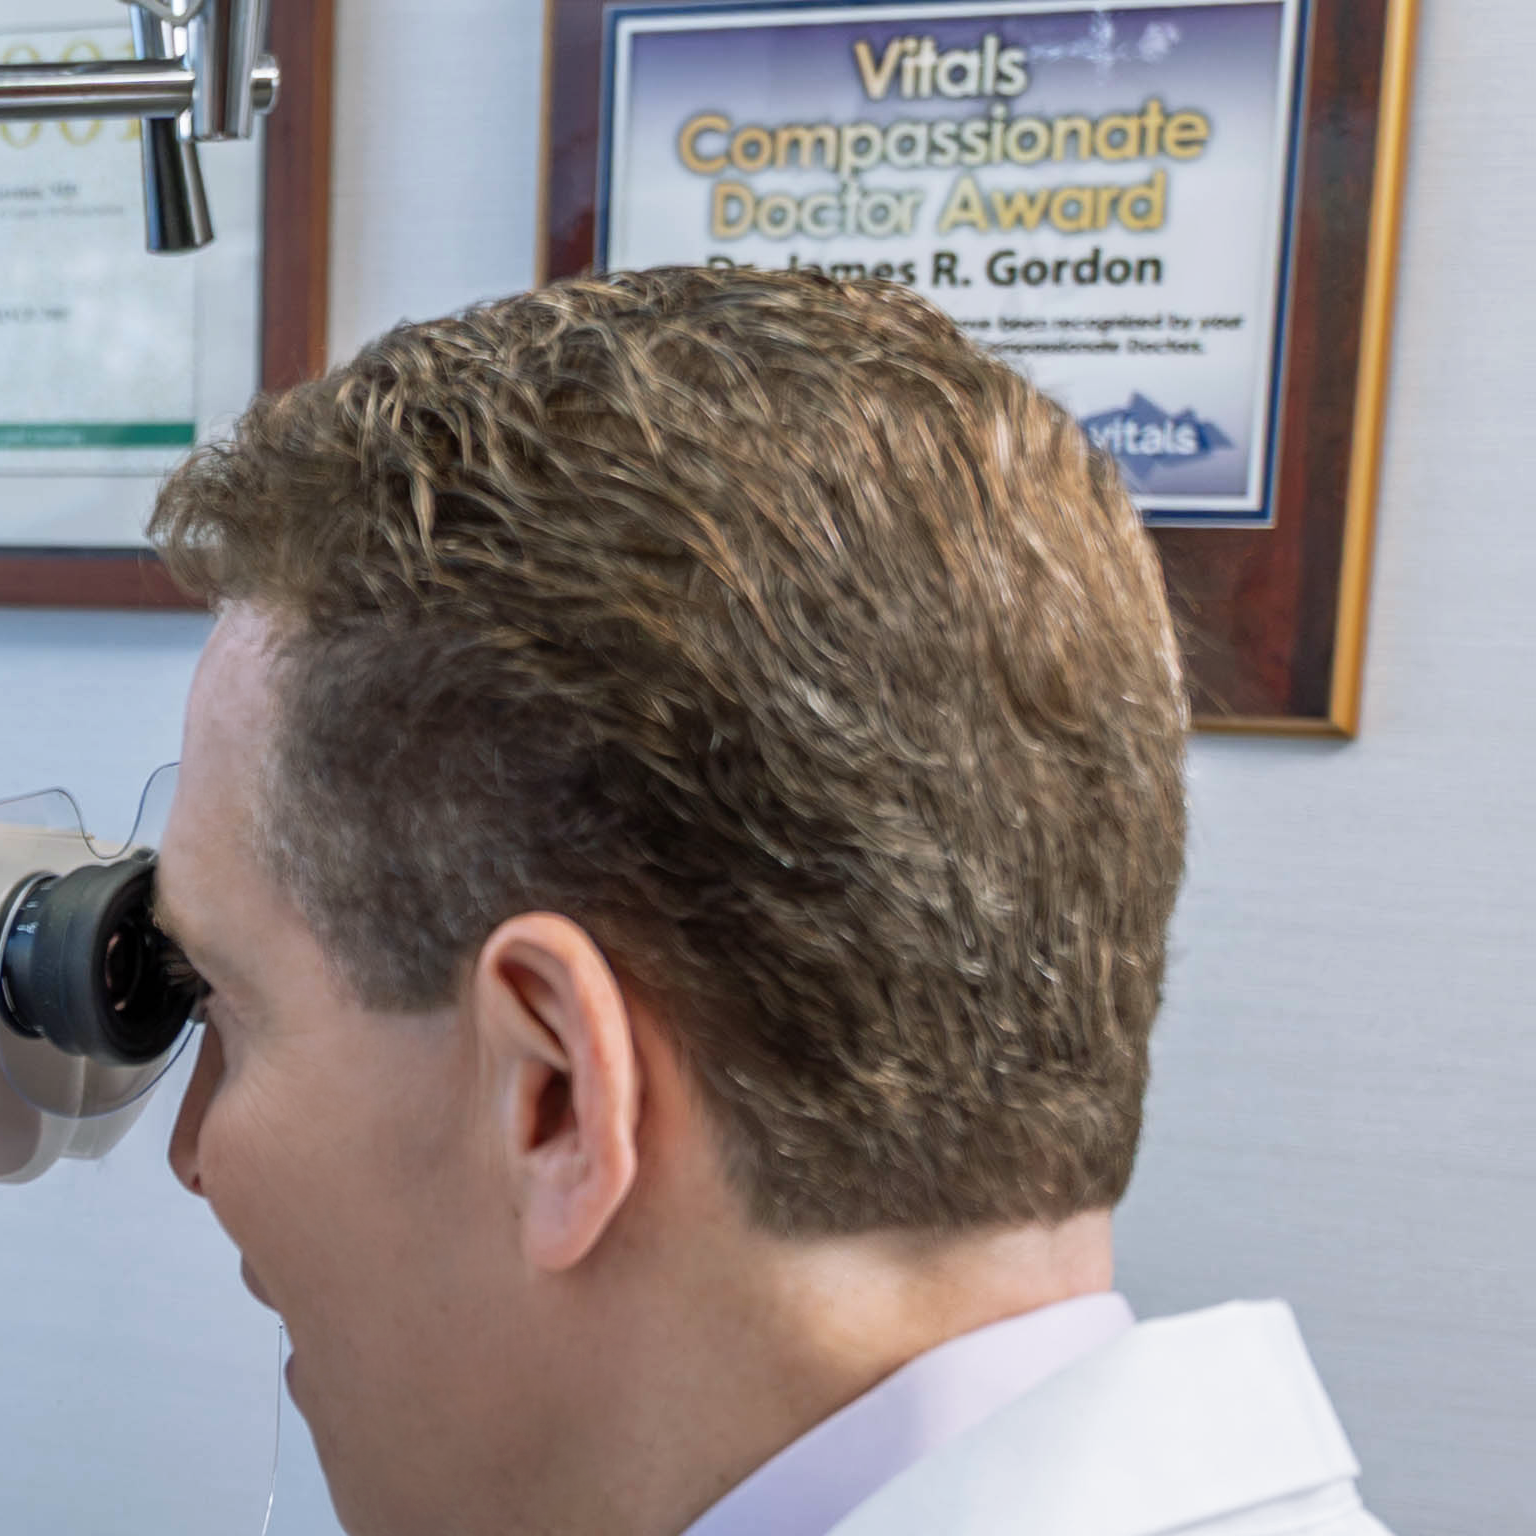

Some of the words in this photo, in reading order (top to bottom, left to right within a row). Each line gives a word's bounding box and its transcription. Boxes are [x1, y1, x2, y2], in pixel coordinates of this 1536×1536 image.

[853, 33, 1029, 100] Vitals
[678, 98, 1211, 175] Compassionate
[709, 179, 923, 241] Doctor
[937, 168, 1168, 235] Award
[931, 252, 972, 288] R.
[985, 247, 1164, 288] Gordon
[1088, 415, 1197, 455] vitals
